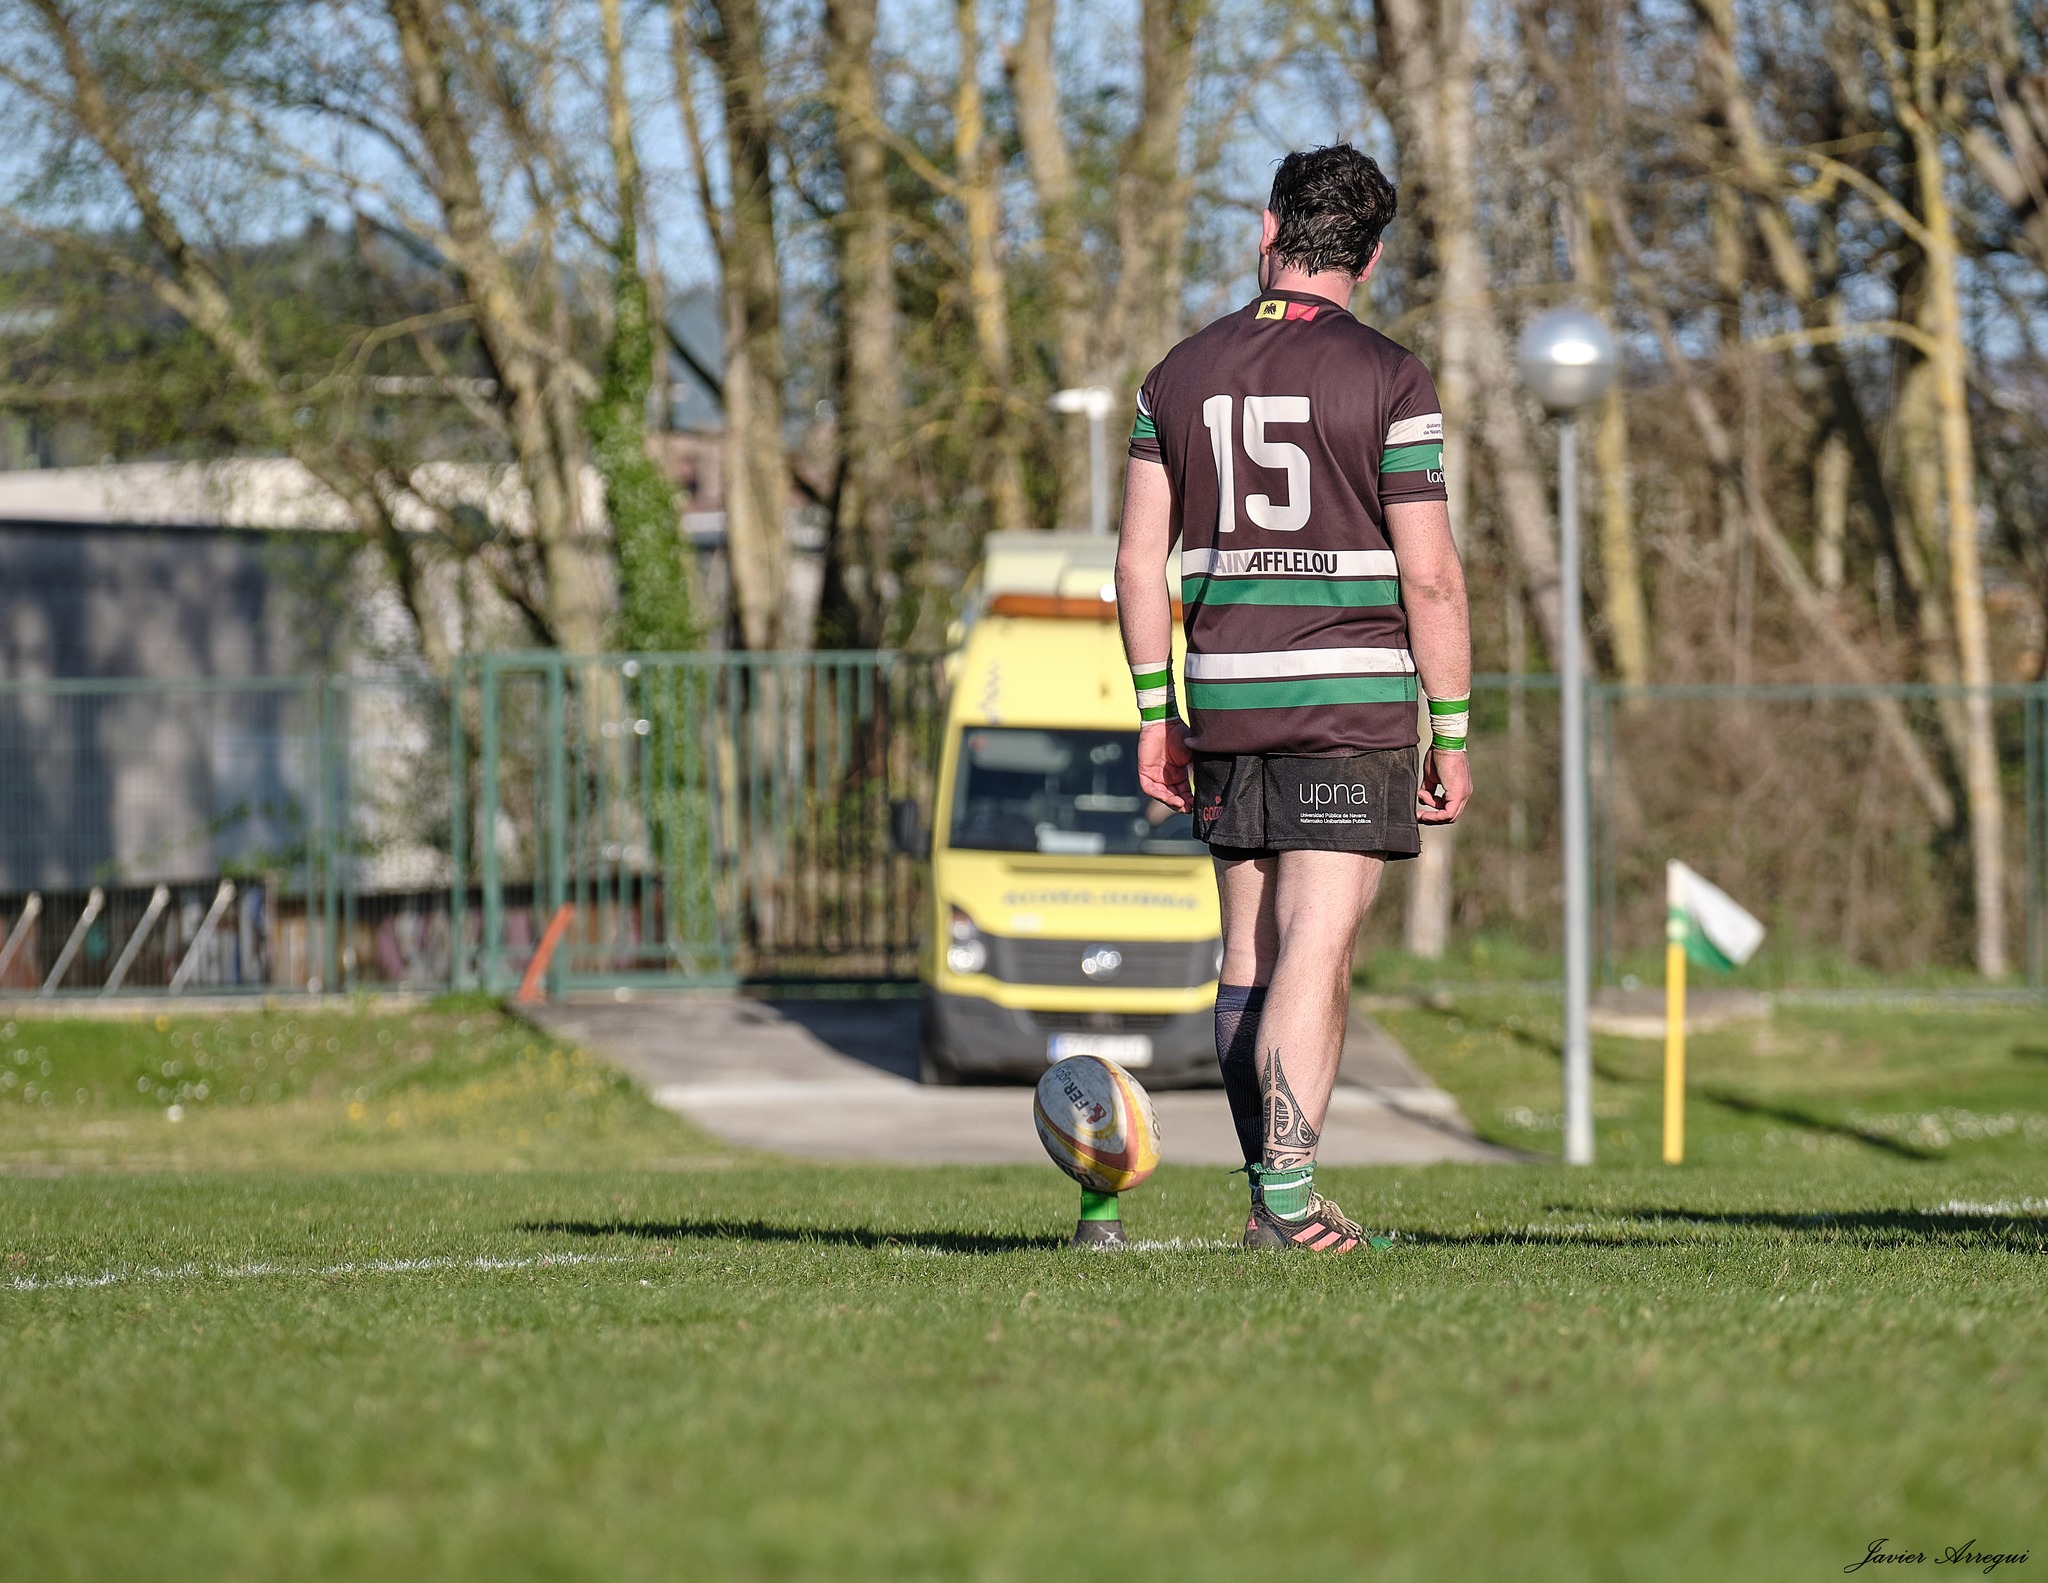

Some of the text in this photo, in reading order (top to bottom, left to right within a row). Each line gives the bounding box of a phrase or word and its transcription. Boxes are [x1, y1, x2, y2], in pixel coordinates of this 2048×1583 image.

[1203, 395, 1310, 533] 15
[1246, 551, 1338, 574] AFFLELOU
[1300, 783, 1368, 810] upna
